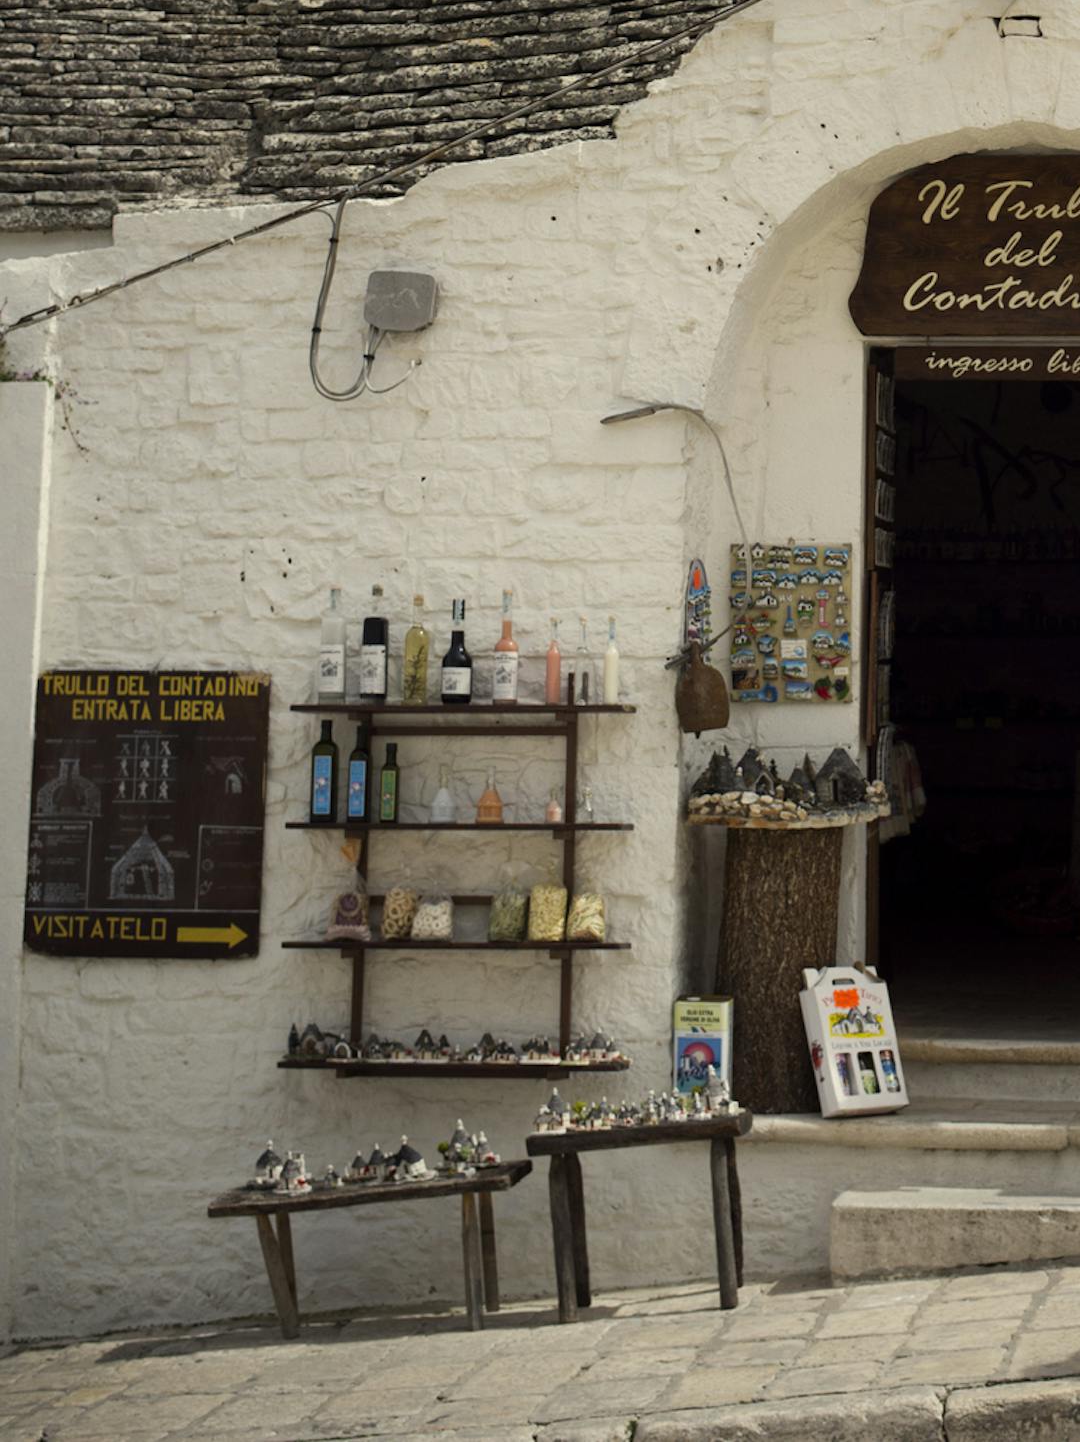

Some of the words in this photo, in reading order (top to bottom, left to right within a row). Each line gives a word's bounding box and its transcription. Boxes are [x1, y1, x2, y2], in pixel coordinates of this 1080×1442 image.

[918, 179, 965, 224] Il
[984, 230, 1063, 267] del
[925, 351, 1034, 378] ingresso
[43, 674, 110, 696] TRULLO
[117, 675, 149, 696] DEL
[159, 675, 259, 697] CONTADINO
[71, 699, 151, 721] ENTRATA
[160, 701, 225, 721] LIBERA
[33, 915, 167, 941] VISITATELO
